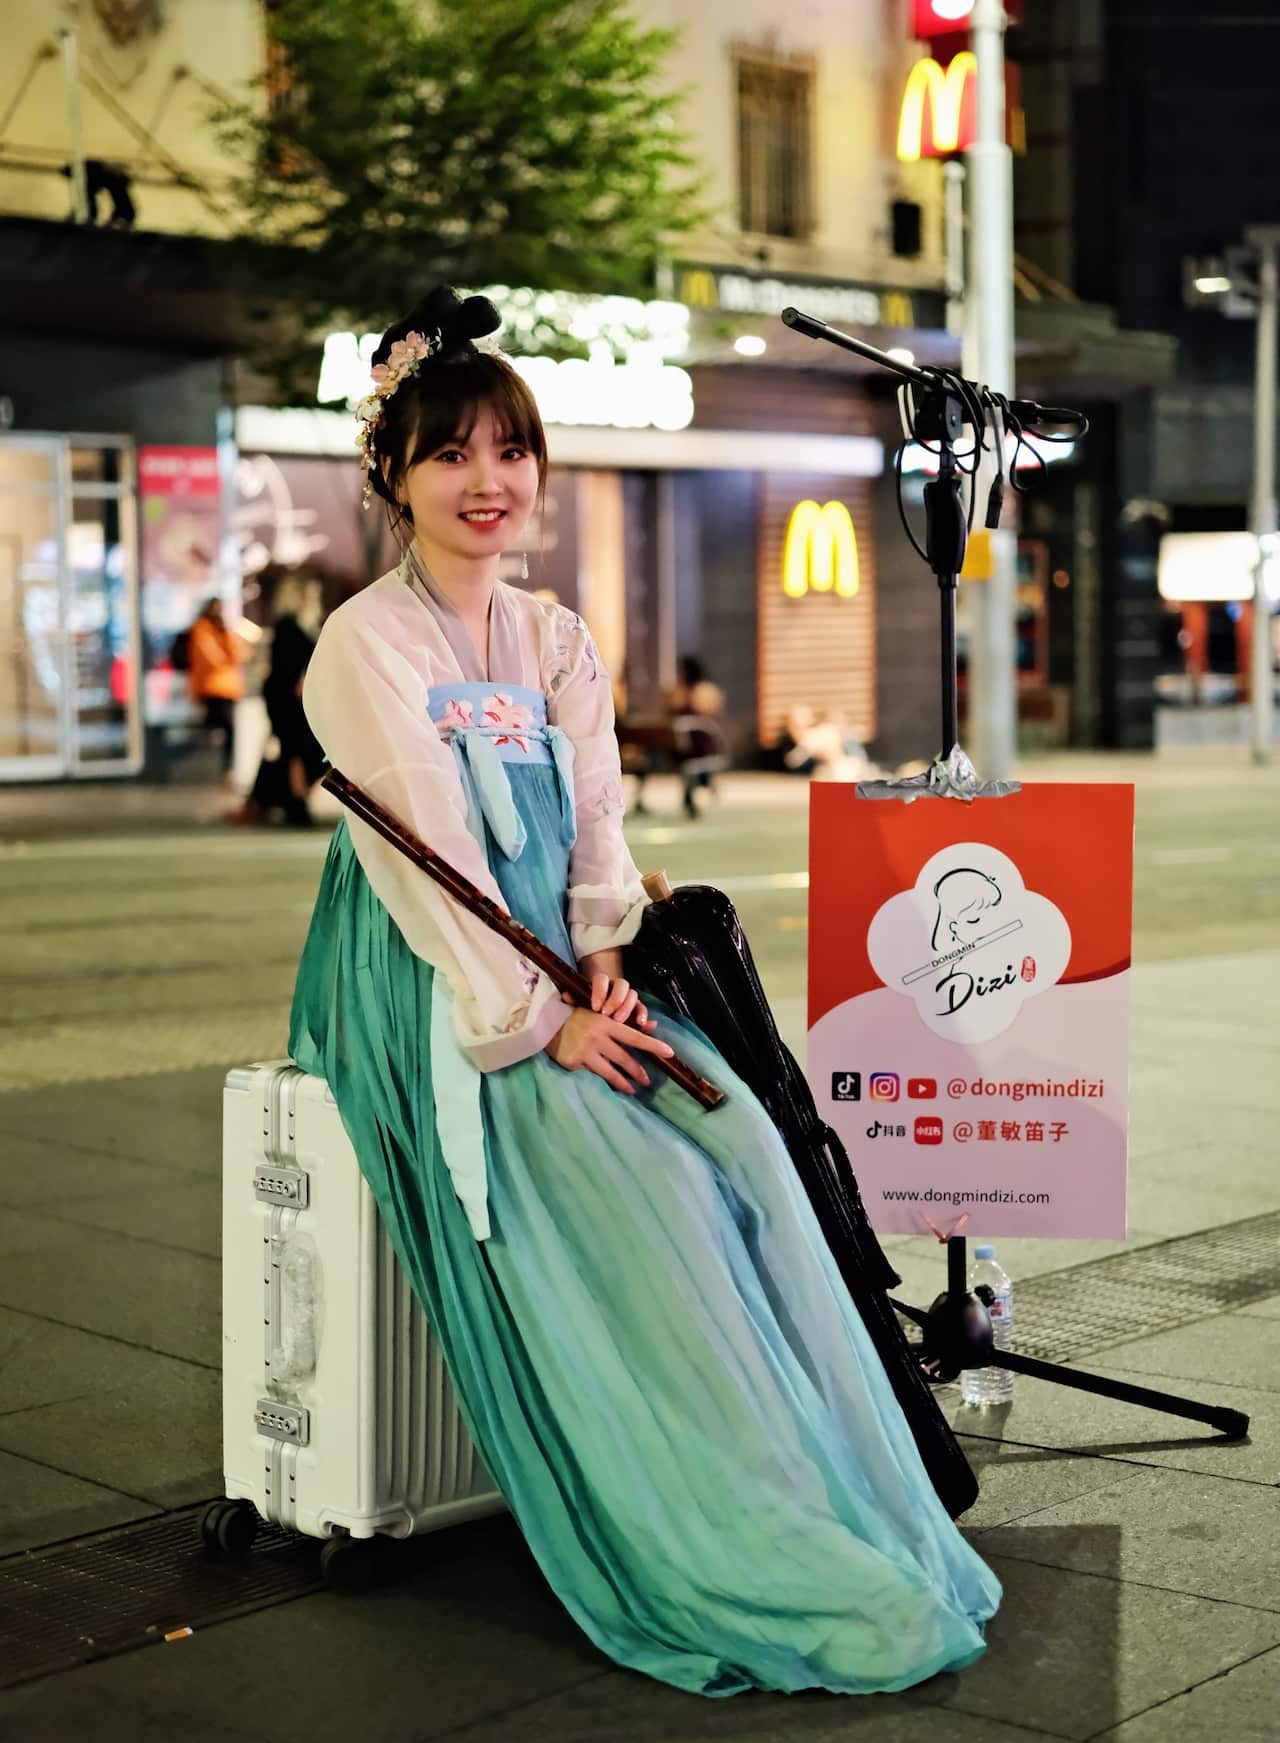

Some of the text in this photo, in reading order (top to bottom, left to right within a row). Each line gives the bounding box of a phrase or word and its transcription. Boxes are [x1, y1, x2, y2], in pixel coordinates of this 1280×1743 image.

[931, 942, 976, 968] DONGMIN
[935, 964, 1017, 1016] Dizi
[946, 1077, 1104, 1102] @dongmindizi
[882, 1187, 1051, 1206] www.dongmindizi.com
